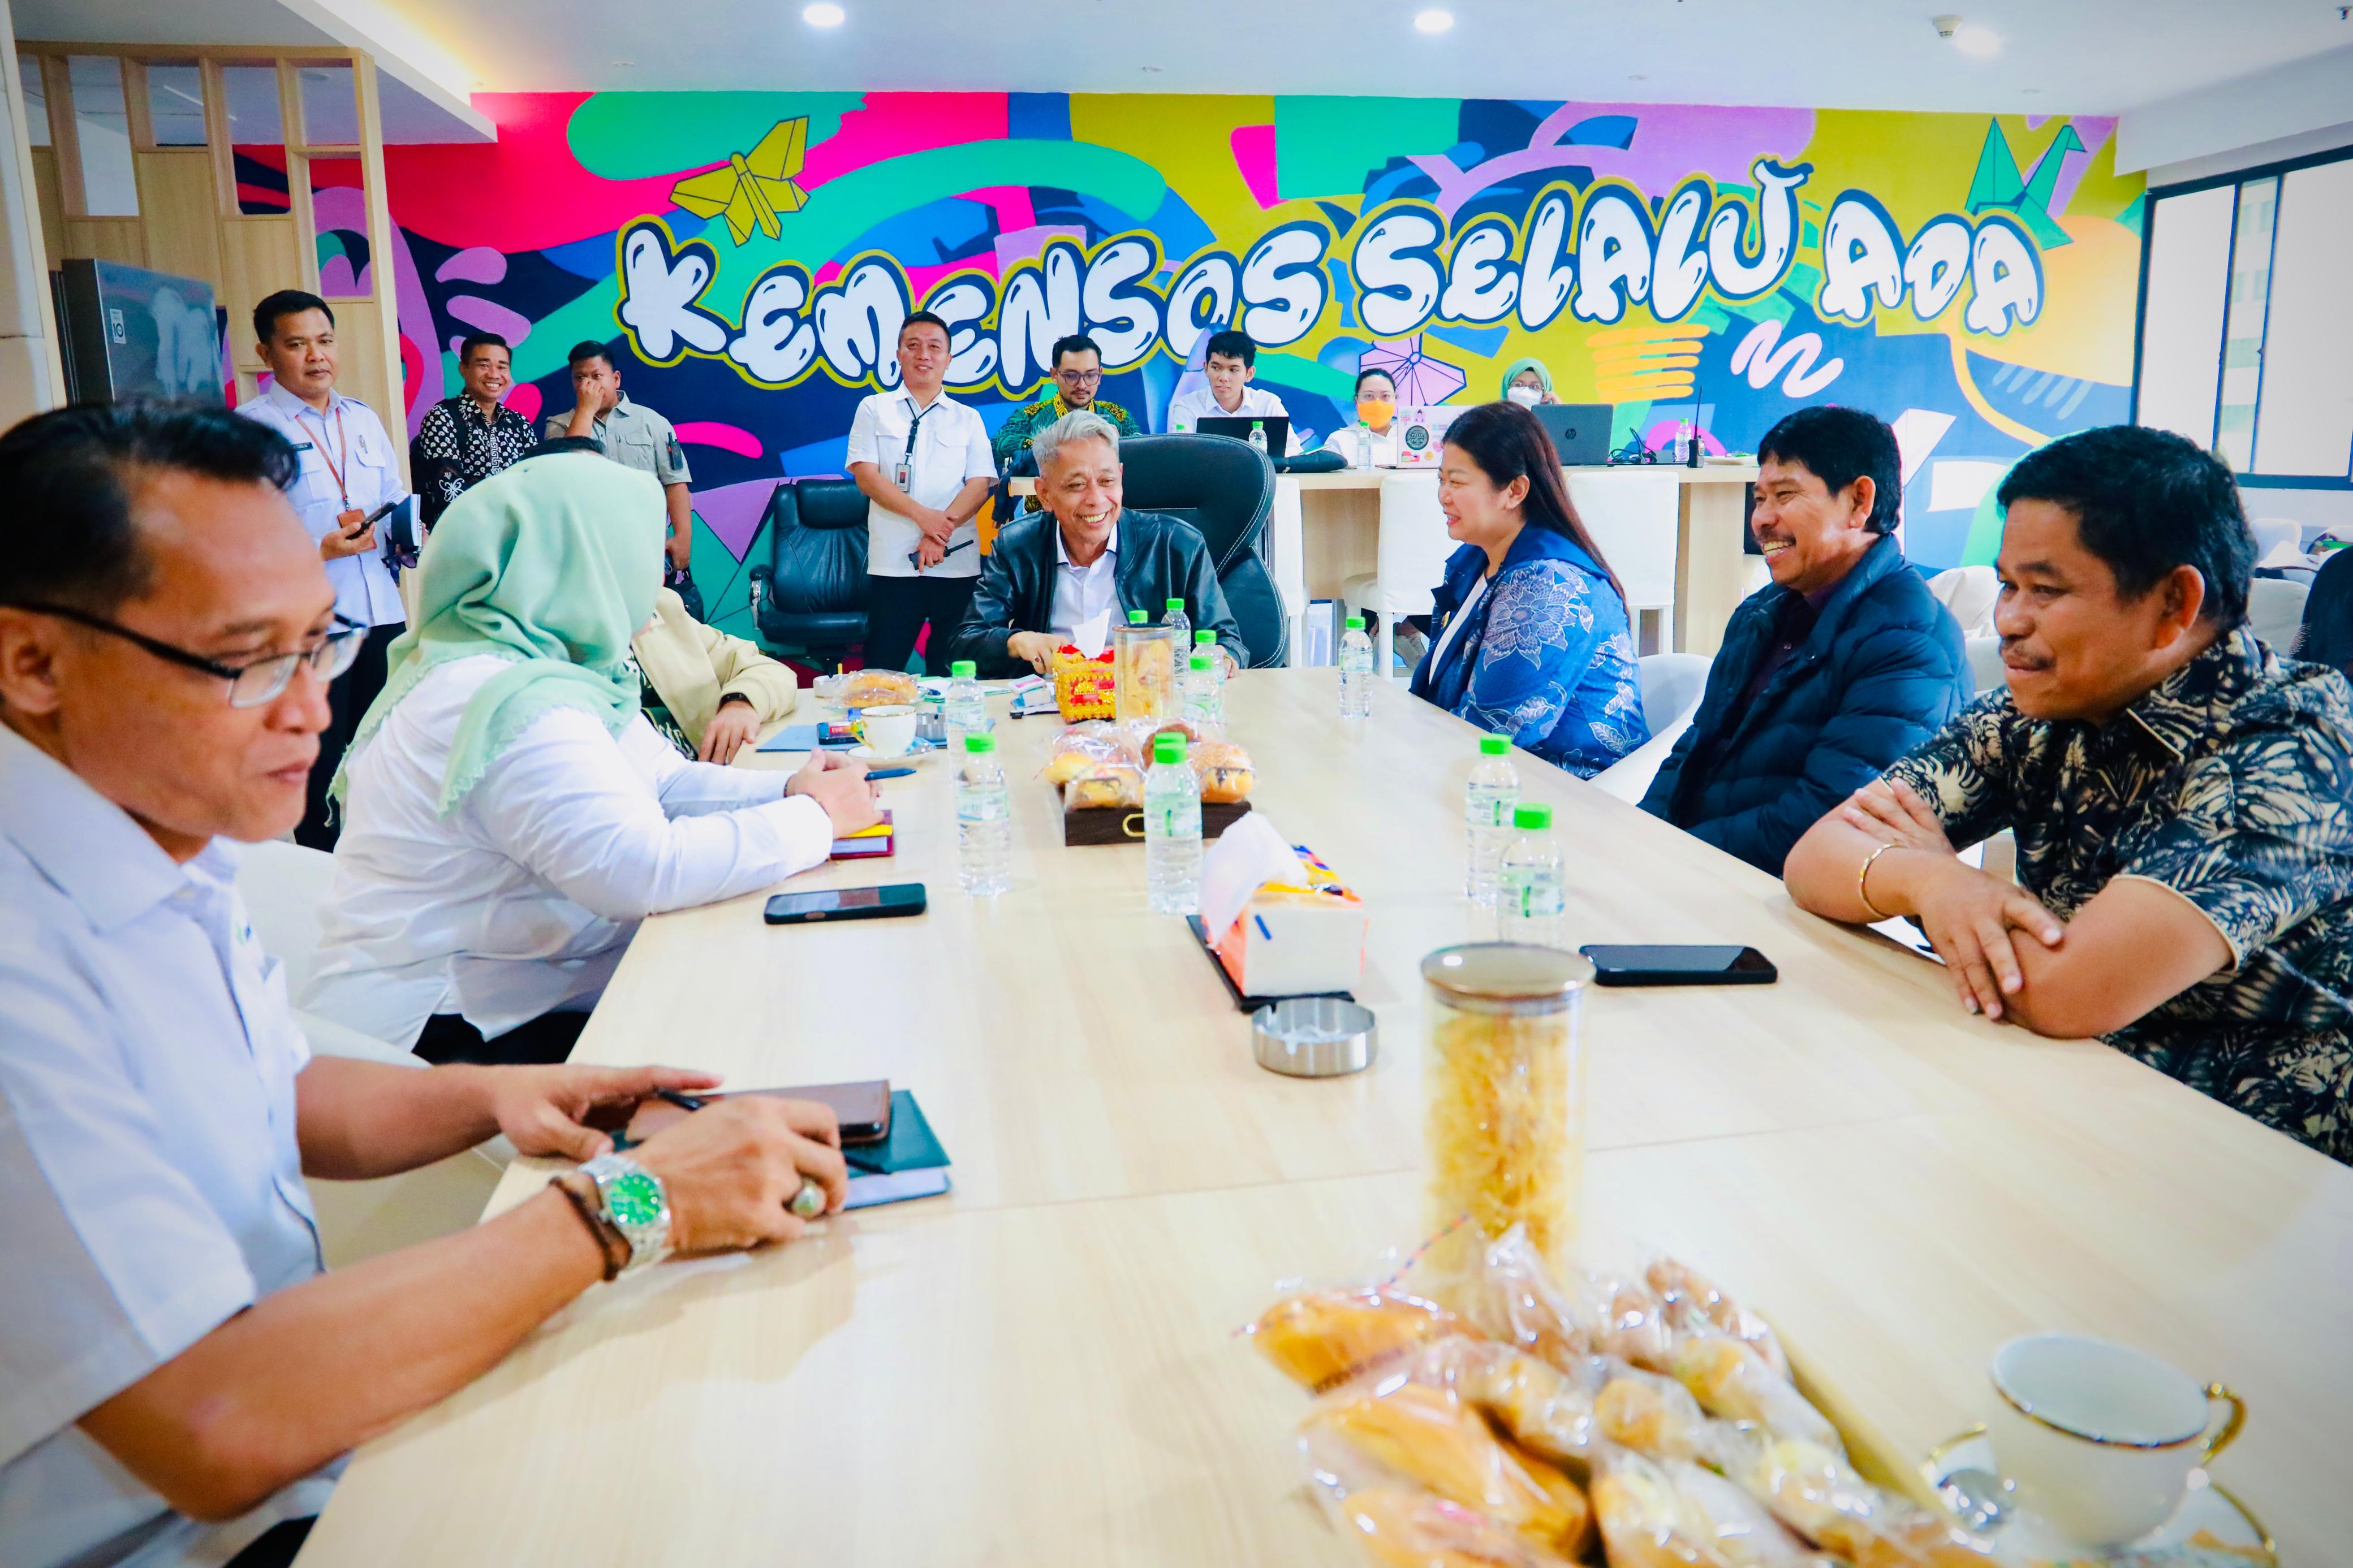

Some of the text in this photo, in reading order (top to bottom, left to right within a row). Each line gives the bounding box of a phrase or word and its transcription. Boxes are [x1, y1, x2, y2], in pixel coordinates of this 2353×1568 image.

[620, 159, 2041, 389] KEMENSOS SELALU ADA
